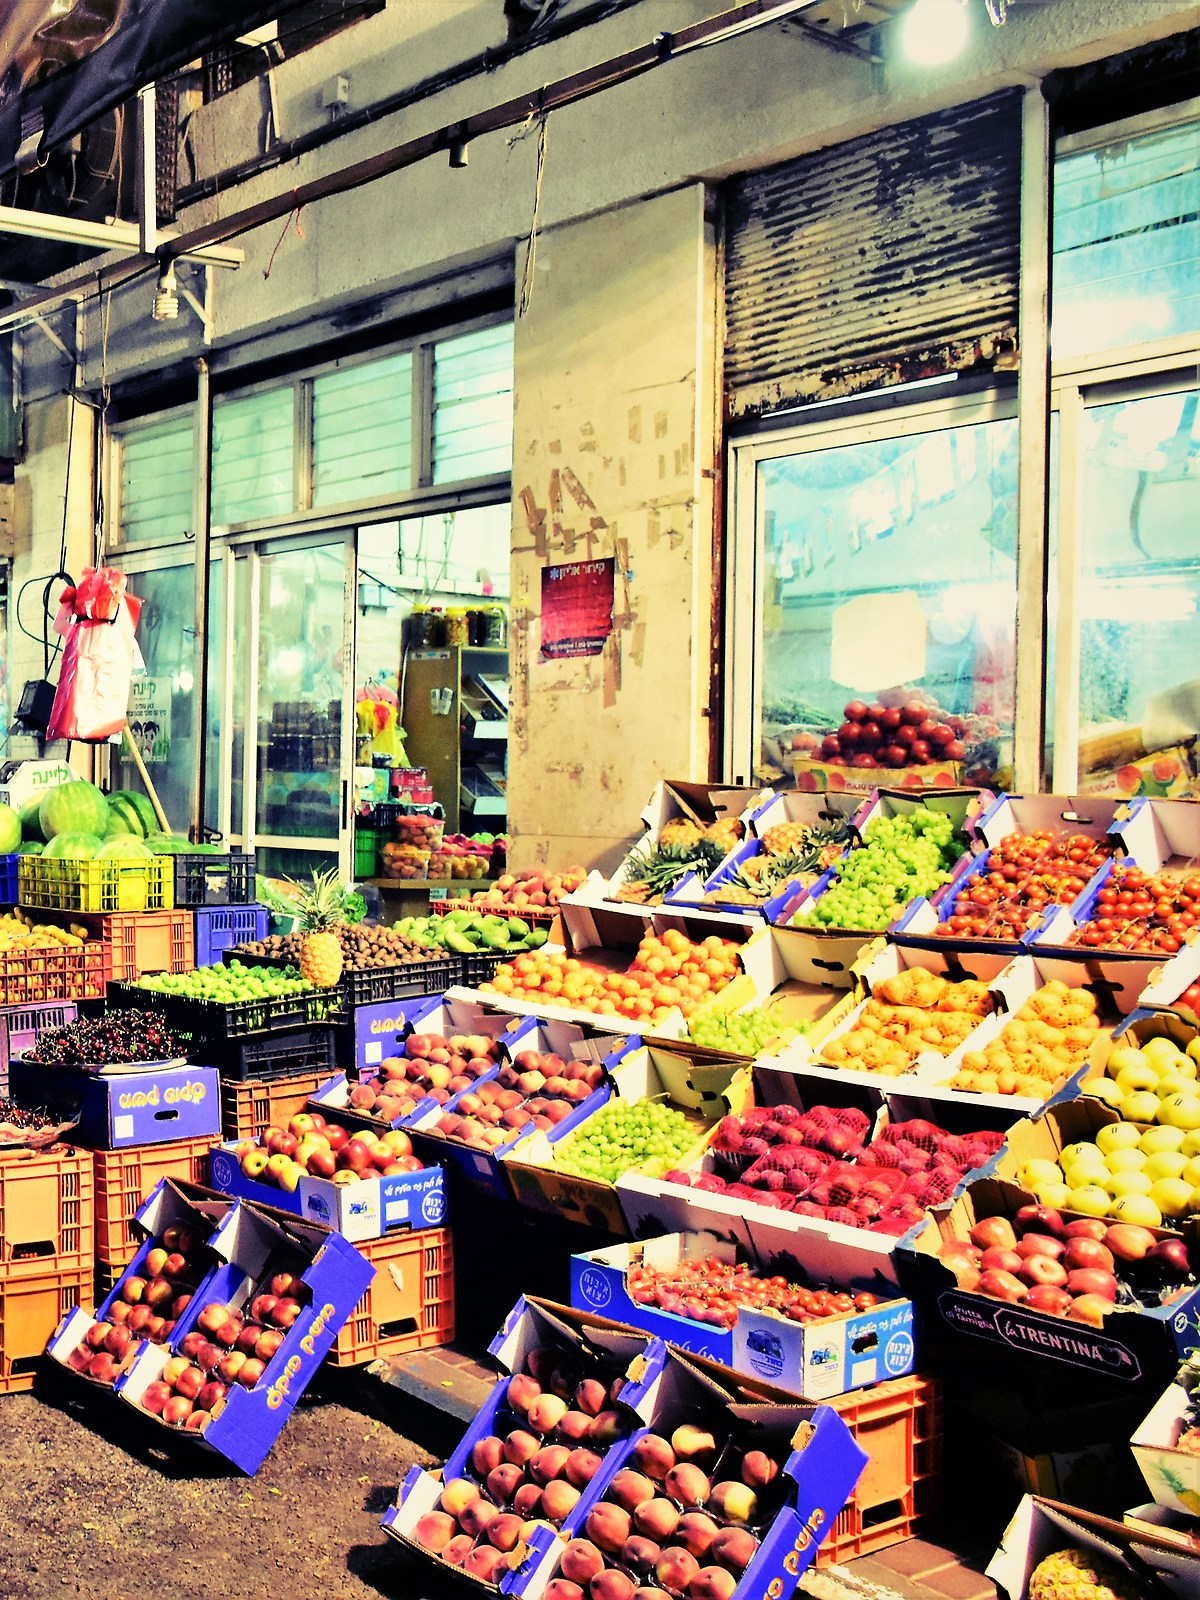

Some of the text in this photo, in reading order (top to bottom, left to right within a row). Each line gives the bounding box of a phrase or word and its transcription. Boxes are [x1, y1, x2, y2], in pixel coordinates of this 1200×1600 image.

[119, 1080, 207, 1109] משק פוקס
[954, 1305, 982, 1319] frutta
[956, 1313, 995, 1331] famiglia
[266, 1303, 336, 1410] משק פוקס
[1004, 1320, 1104, 1362] la TRENTINA
[783, 1507, 826, 1577] משק
